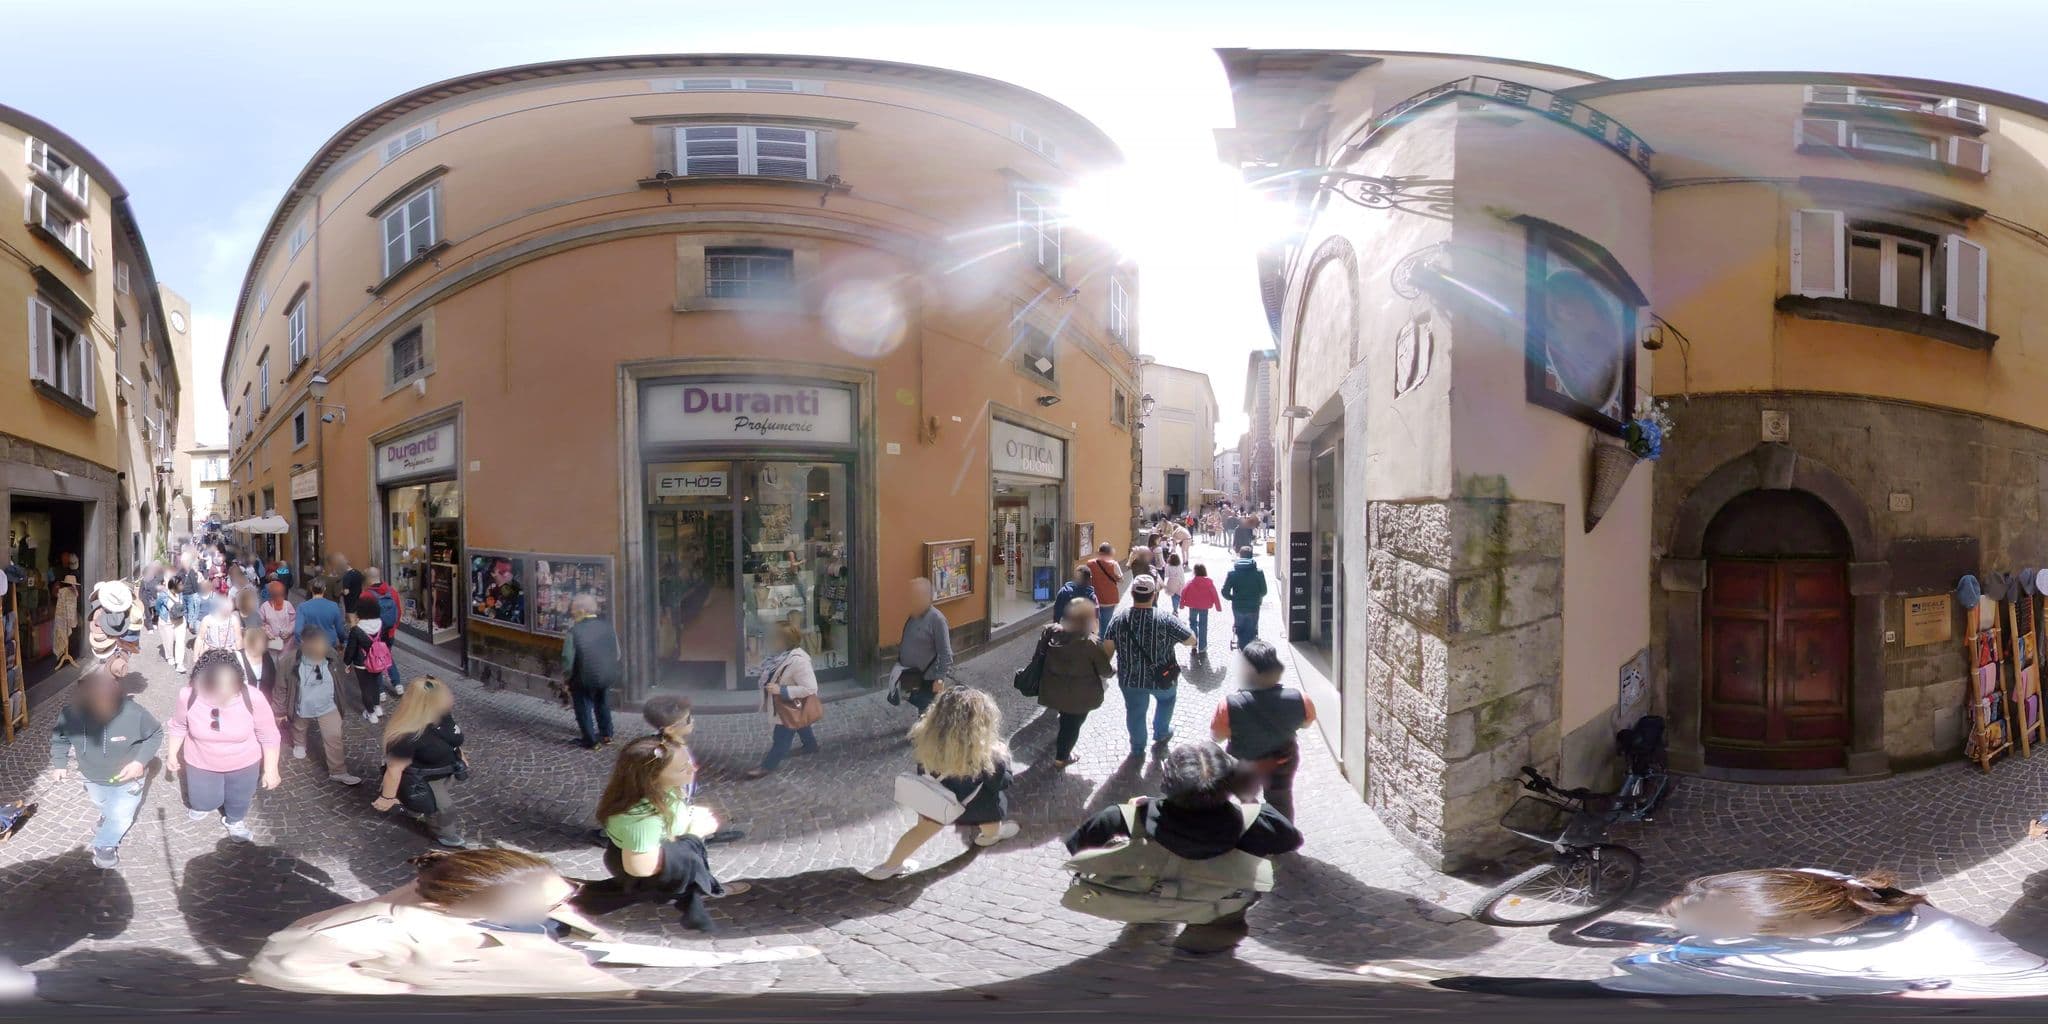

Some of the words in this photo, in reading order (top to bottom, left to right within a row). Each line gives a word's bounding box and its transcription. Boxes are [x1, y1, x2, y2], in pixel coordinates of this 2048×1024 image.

[683, 387, 819, 416] Duranti
[734, 416, 813, 435] Profumerie
[388, 432, 439, 461] Duranti
[1006, 439, 1053, 464] OTTICA
